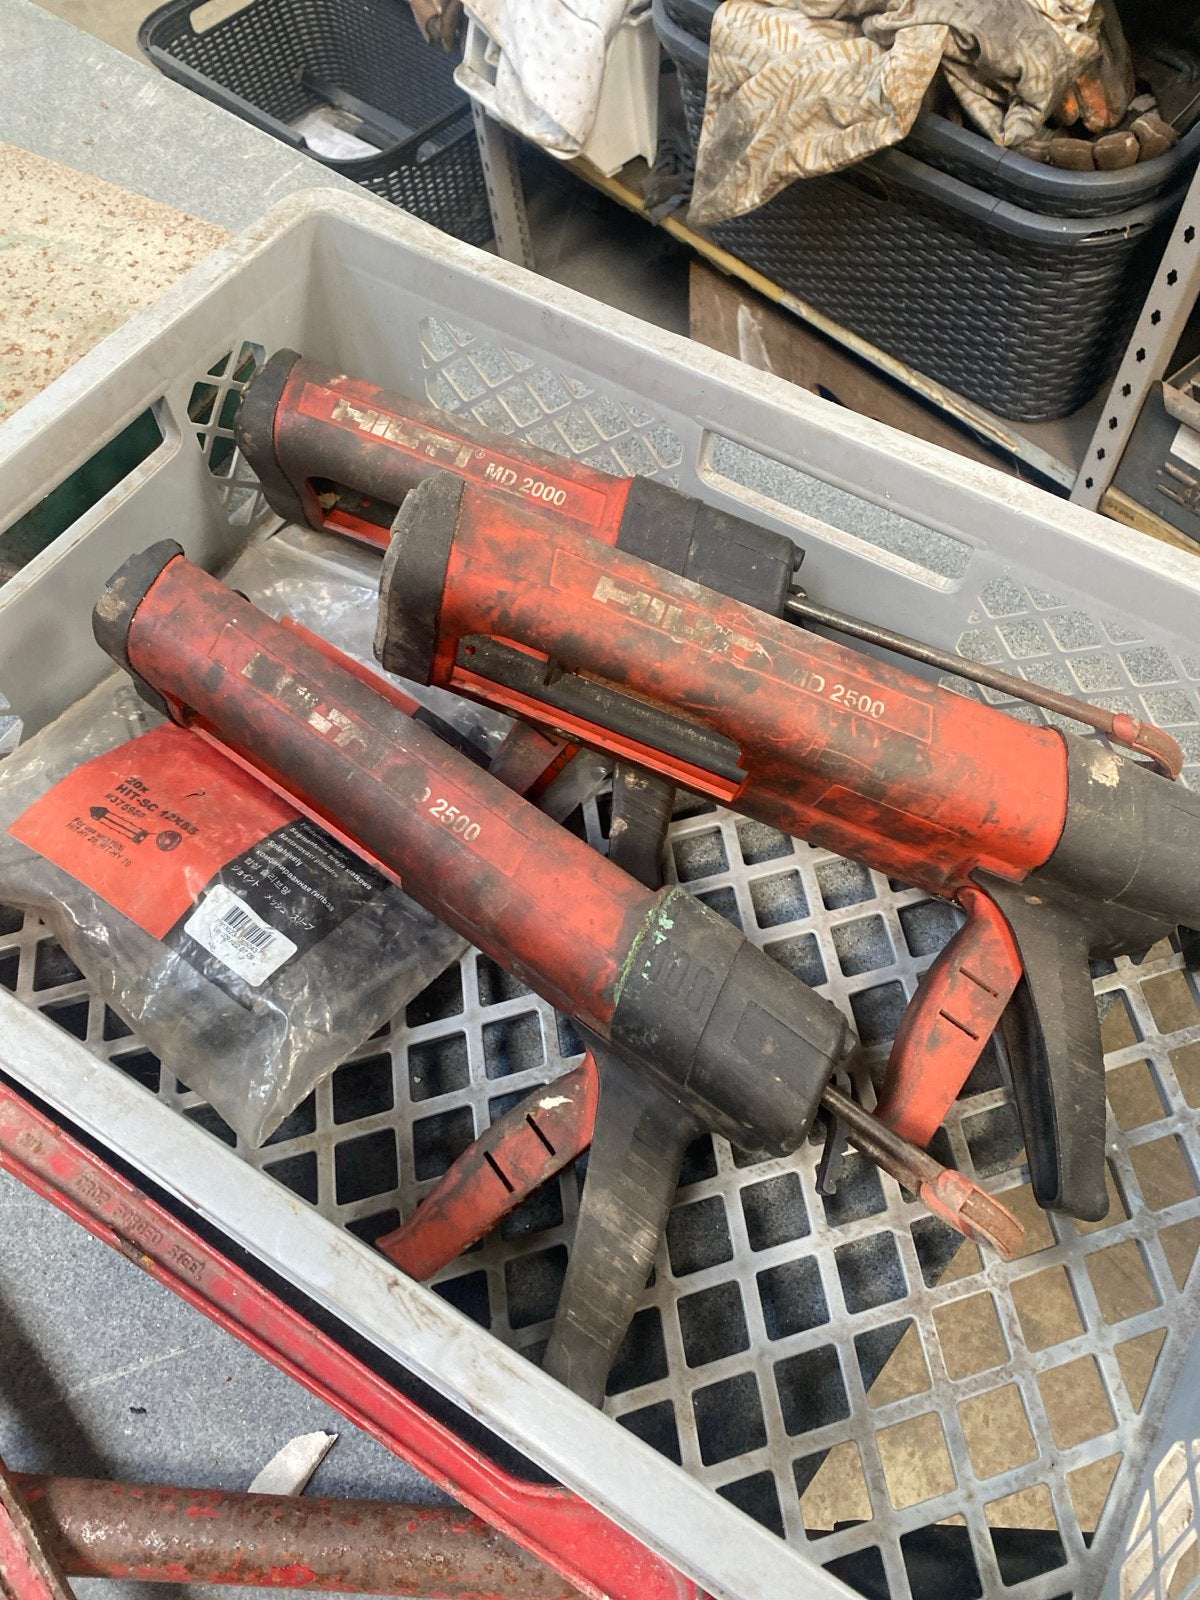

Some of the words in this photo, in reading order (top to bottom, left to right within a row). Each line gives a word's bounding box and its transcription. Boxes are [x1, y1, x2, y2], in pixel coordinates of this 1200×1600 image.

[484, 462, 518, 487] MD
[518, 476, 568, 507] 2000
[829, 684, 886, 719] 2500
[115, 783, 159, 812] HIT-SC
[428, 798, 482, 841] 2500
